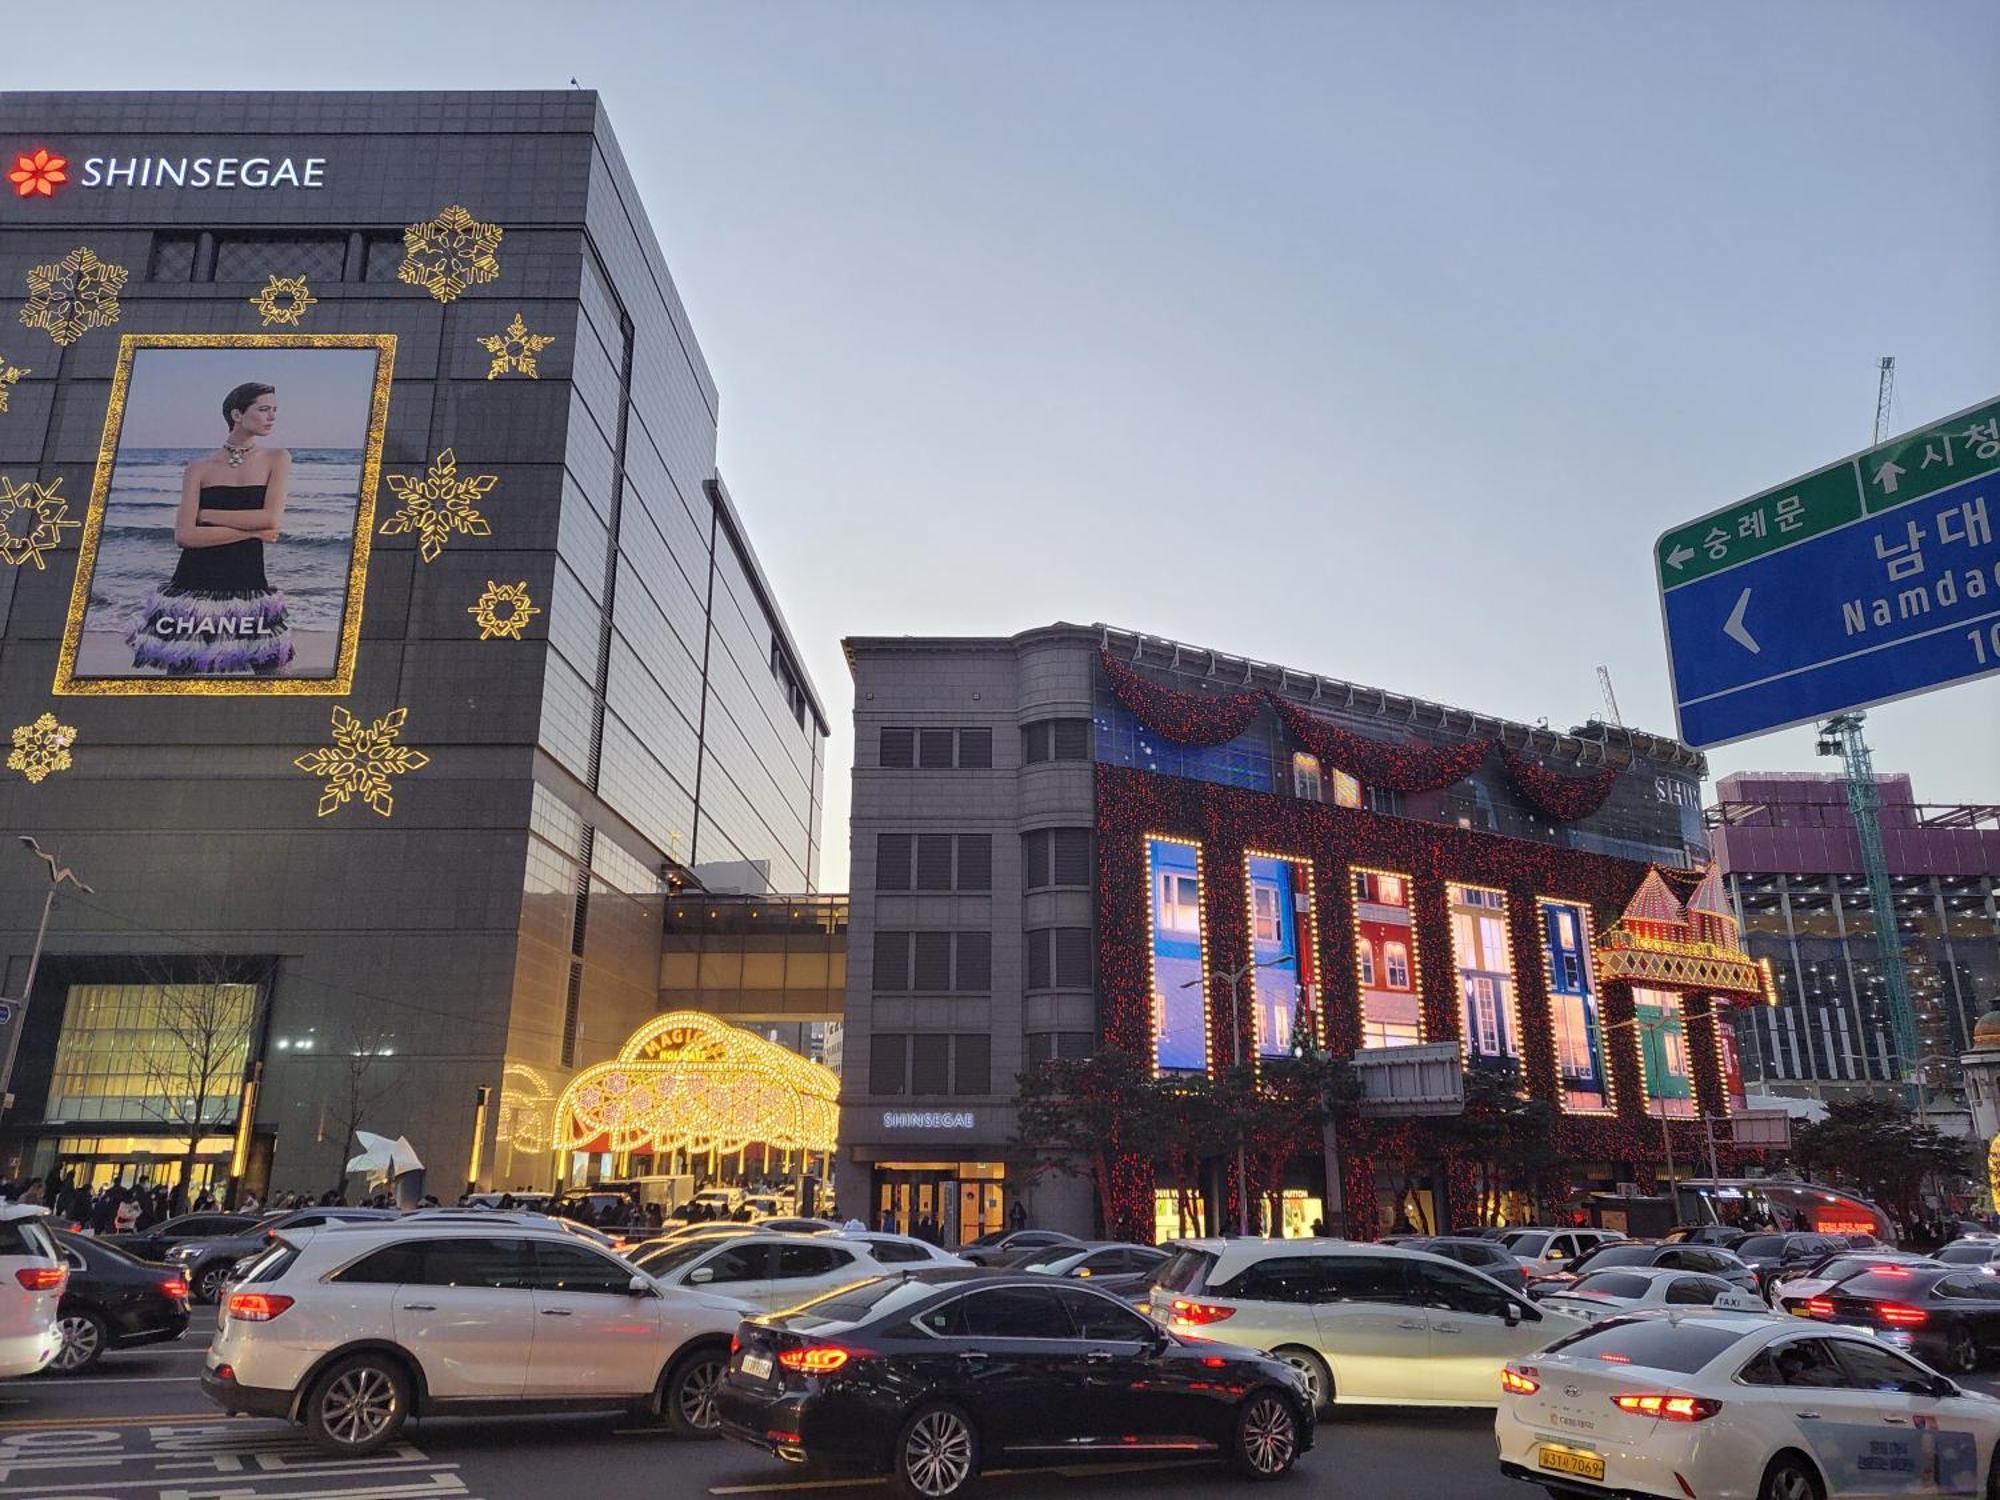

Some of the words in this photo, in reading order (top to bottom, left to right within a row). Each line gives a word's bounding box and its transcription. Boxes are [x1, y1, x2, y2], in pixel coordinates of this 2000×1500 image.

[81, 157, 327, 188] SHINSEGAE
[1920, 418, 2000, 469] 시청
[1703, 495, 1806, 560] 숭례문
[1873, 496, 1993, 582] 남대
[155, 616, 272, 634] CHANEL
[882, 1111, 976, 1129] SHINSEGAE
[1719, 1296, 1741, 1308] TAXI
[1571, 1457, 1600, 1475] 7069
